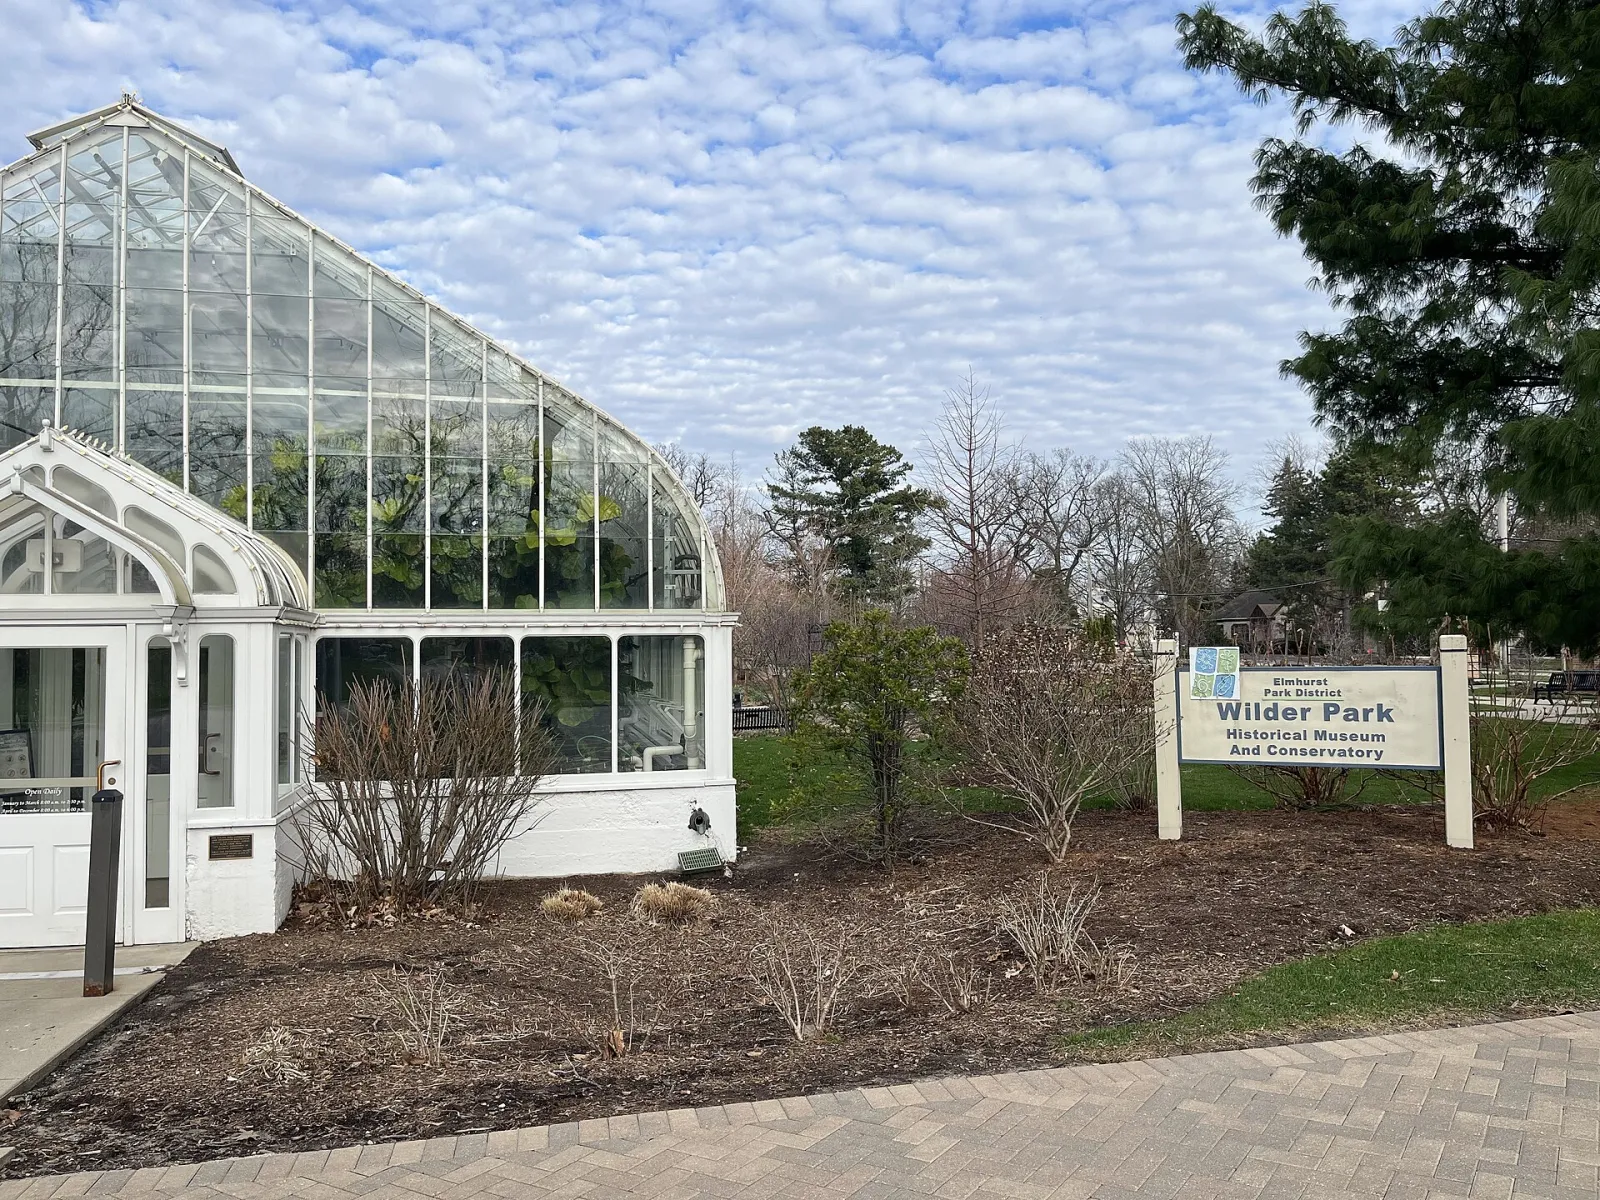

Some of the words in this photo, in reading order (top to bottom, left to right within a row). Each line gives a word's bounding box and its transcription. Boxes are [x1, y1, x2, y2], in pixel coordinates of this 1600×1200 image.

[1273, 677, 1328, 686] Elmhurst
[1264, 688, 1291, 697] Park
[1295, 688, 1342, 698] District
[1217, 702, 1311, 722] Wilder
[1323, 702, 1395, 723] Park
[1226, 729, 1308, 742] Historical
[1314, 730, 1386, 743] Museum
[1229, 744, 1261, 756] And
[1266, 745, 1384, 761] Conservatory
[24, 788, 42, 796] Open
[43, 787, 62, 796] Daily
